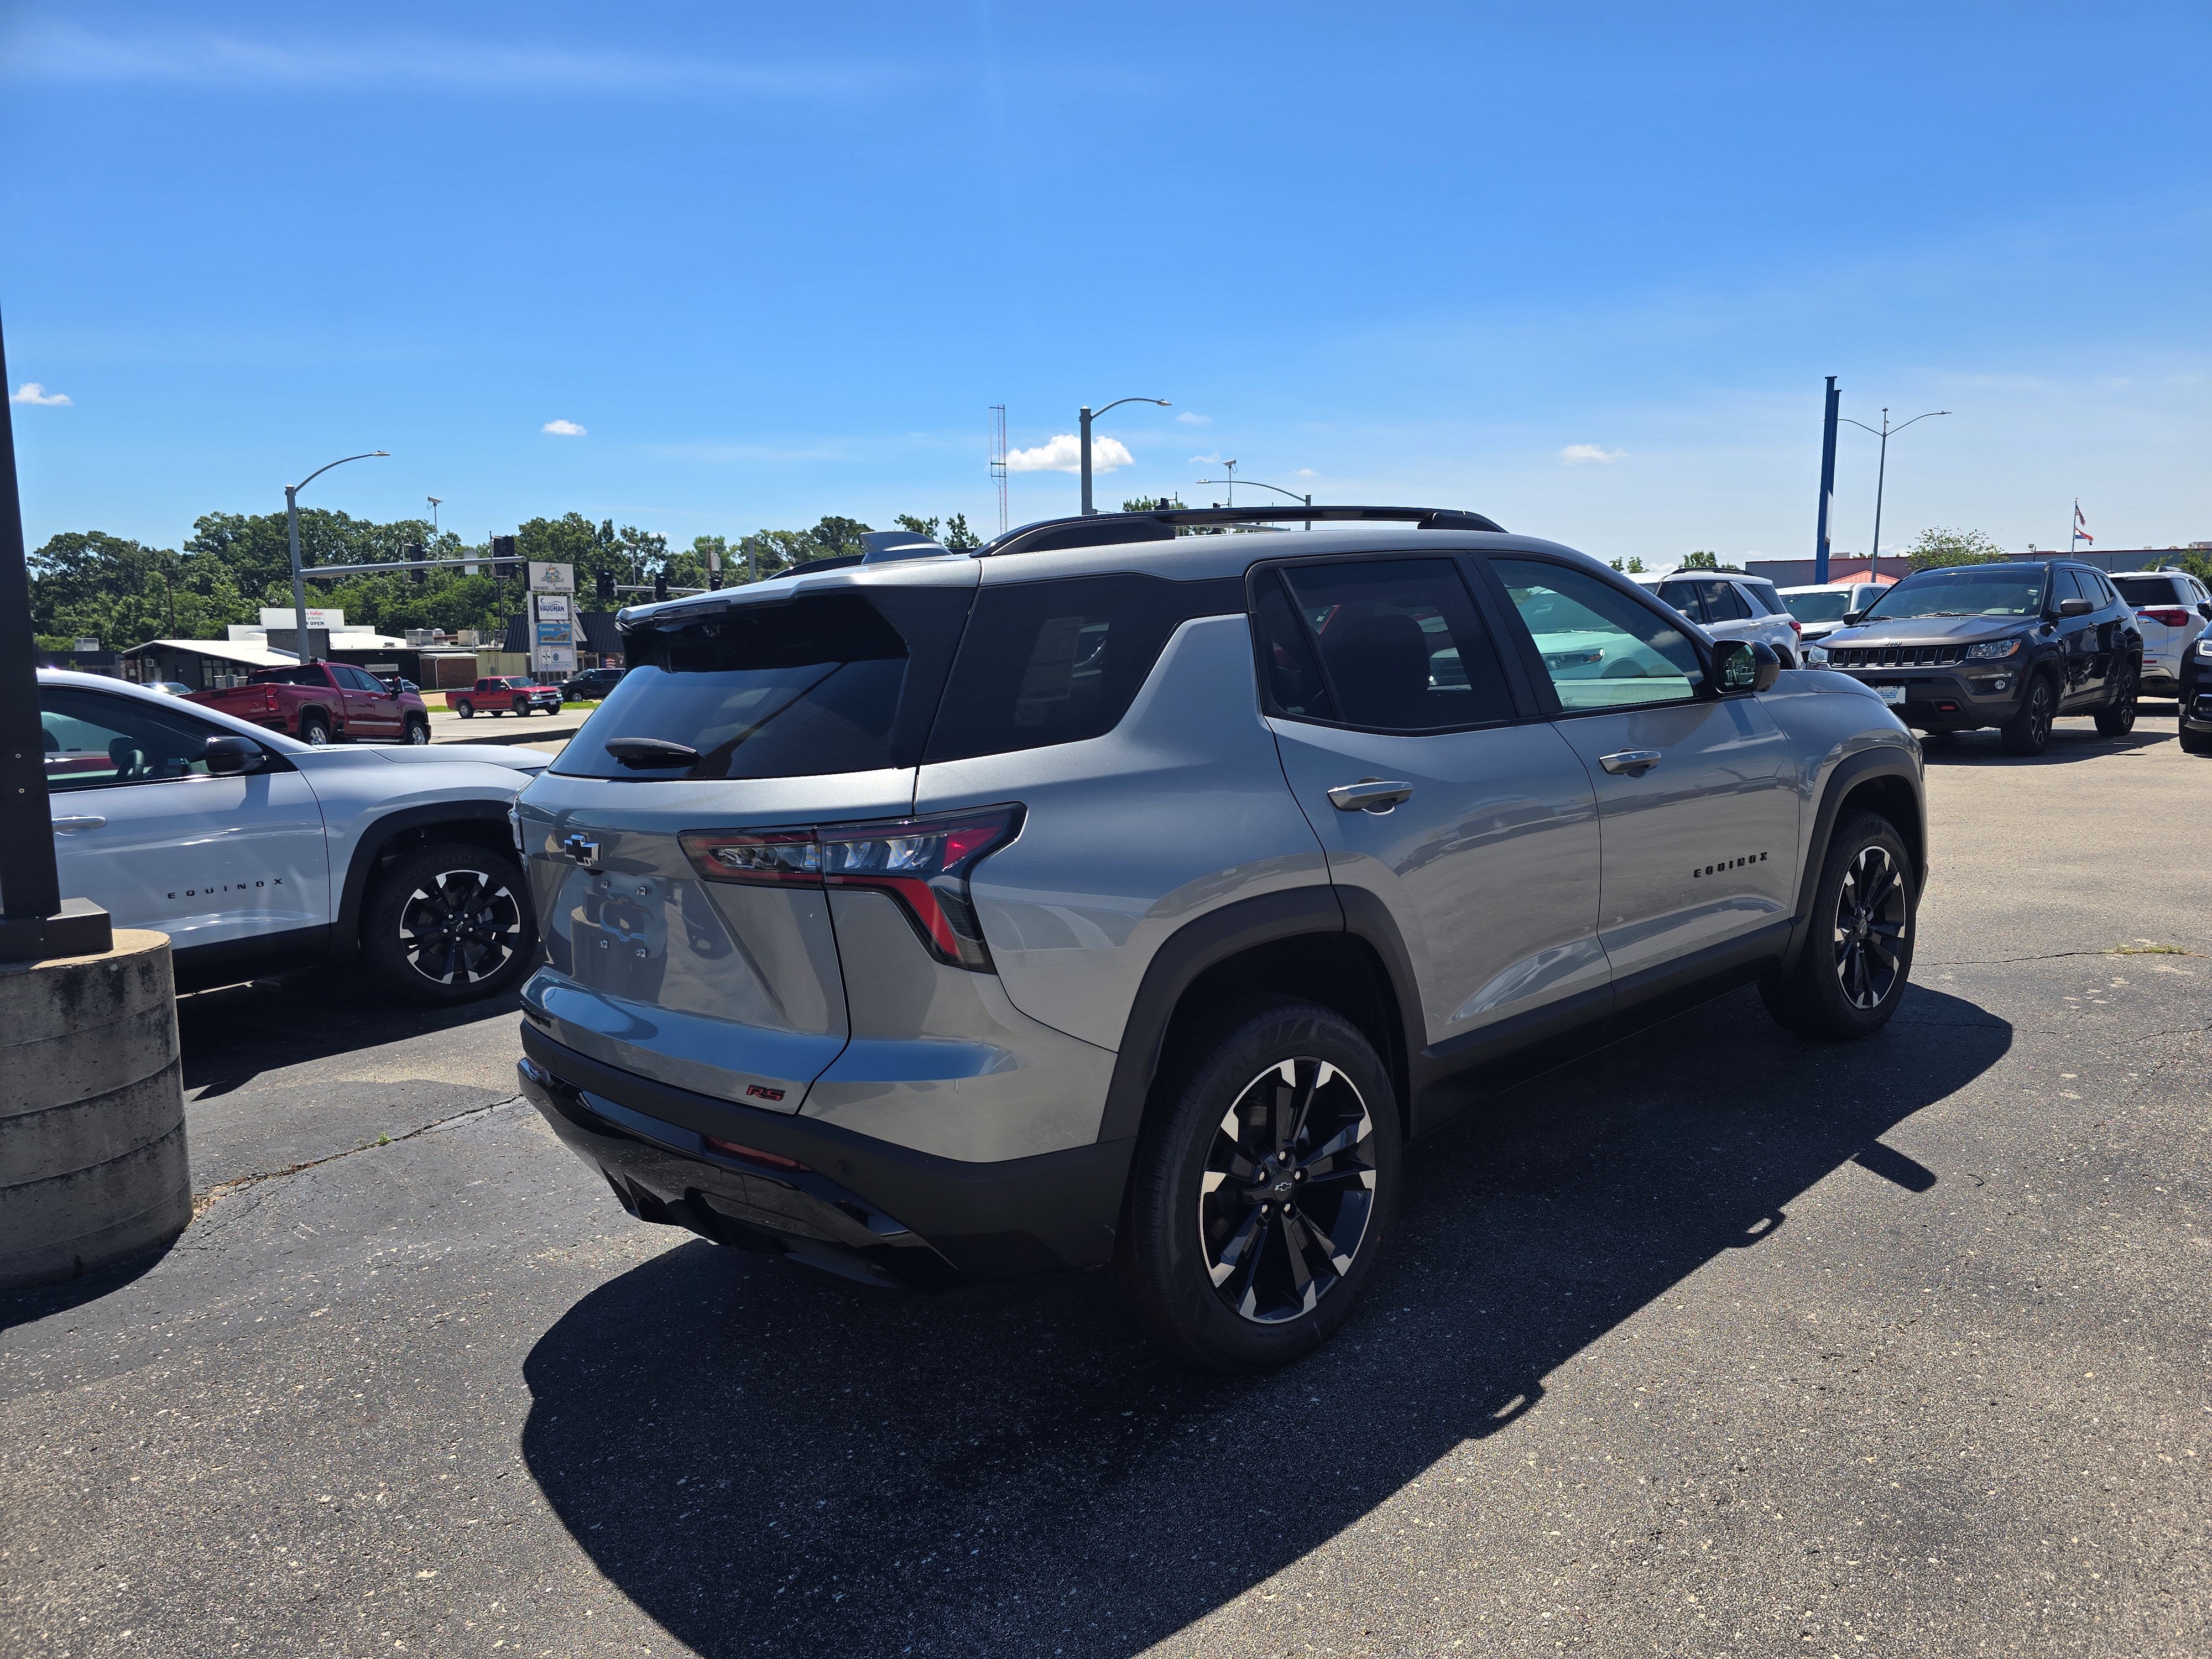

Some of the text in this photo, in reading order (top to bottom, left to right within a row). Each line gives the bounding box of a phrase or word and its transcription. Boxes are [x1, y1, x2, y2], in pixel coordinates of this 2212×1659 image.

[1884, 638, 1902, 647] Jeep
[1693, 852, 1768, 878] EQUINOX
[168, 878, 283, 900] EQUINOX
[745, 1084, 786, 1102] RS
